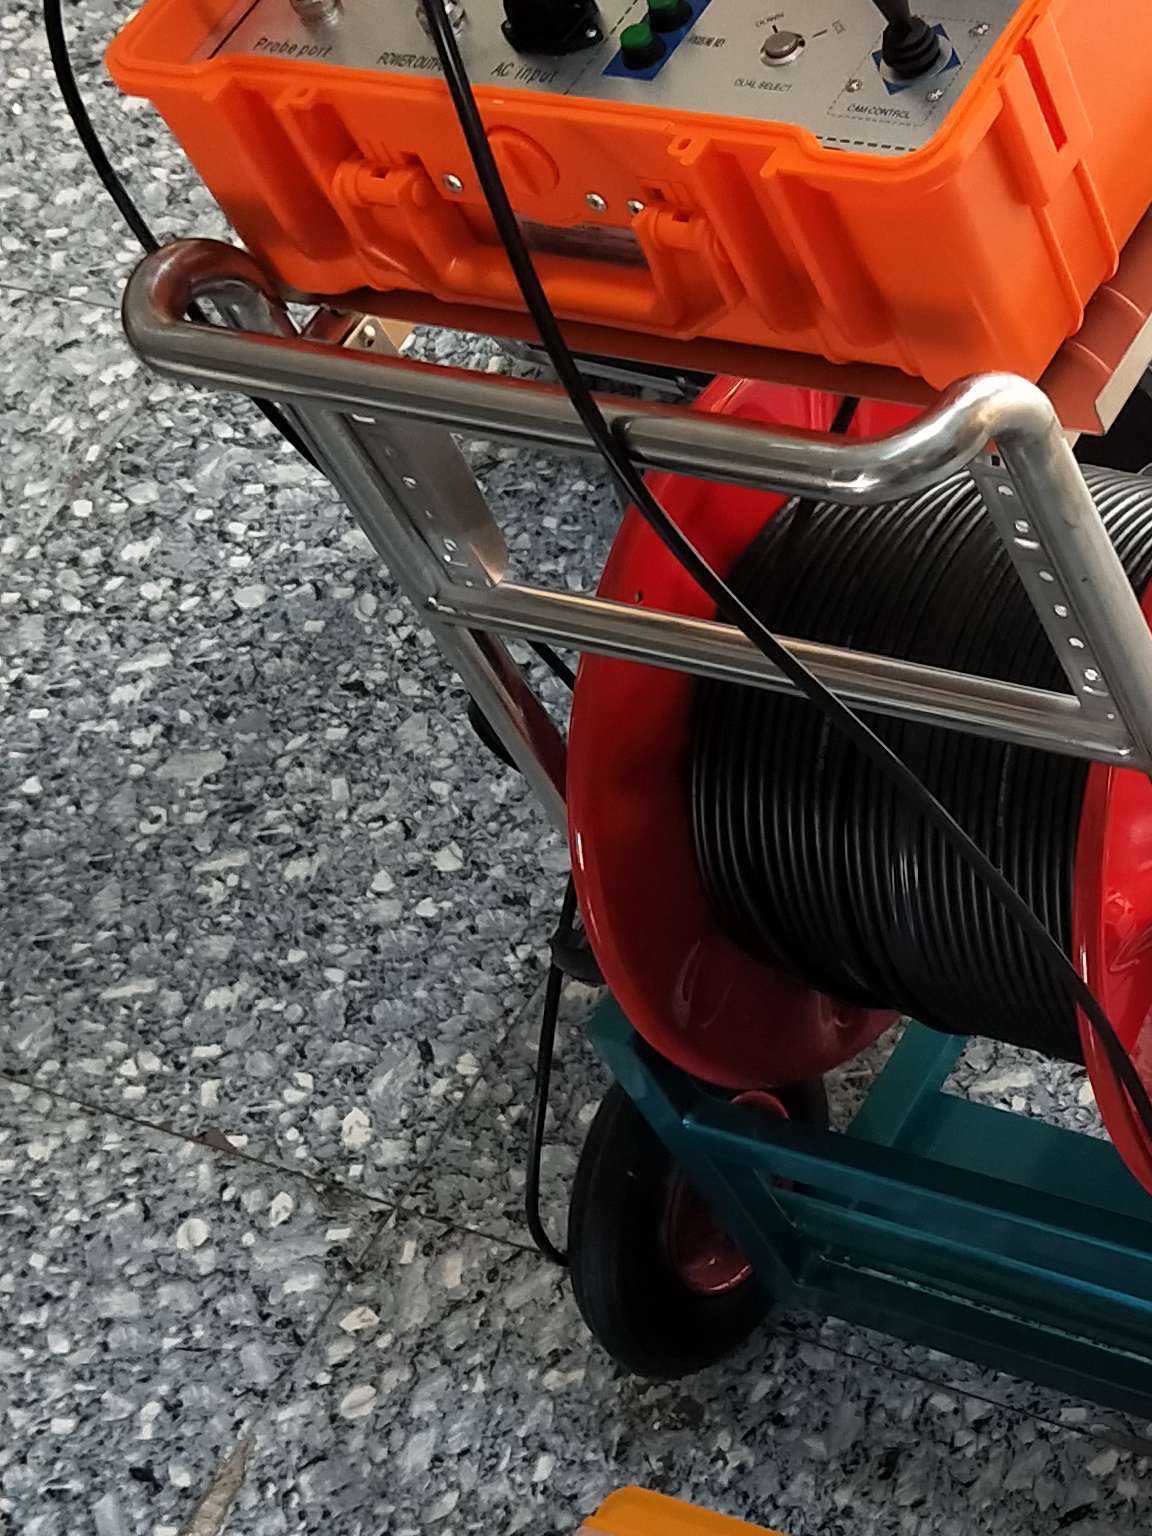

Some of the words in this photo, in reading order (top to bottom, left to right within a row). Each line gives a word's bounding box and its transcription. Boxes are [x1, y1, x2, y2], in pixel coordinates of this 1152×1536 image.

[252, 36, 298, 55] Probe
[295, 44, 333, 59] port
[490, 62, 515, 77] AC
[513, 63, 559, 85] input
